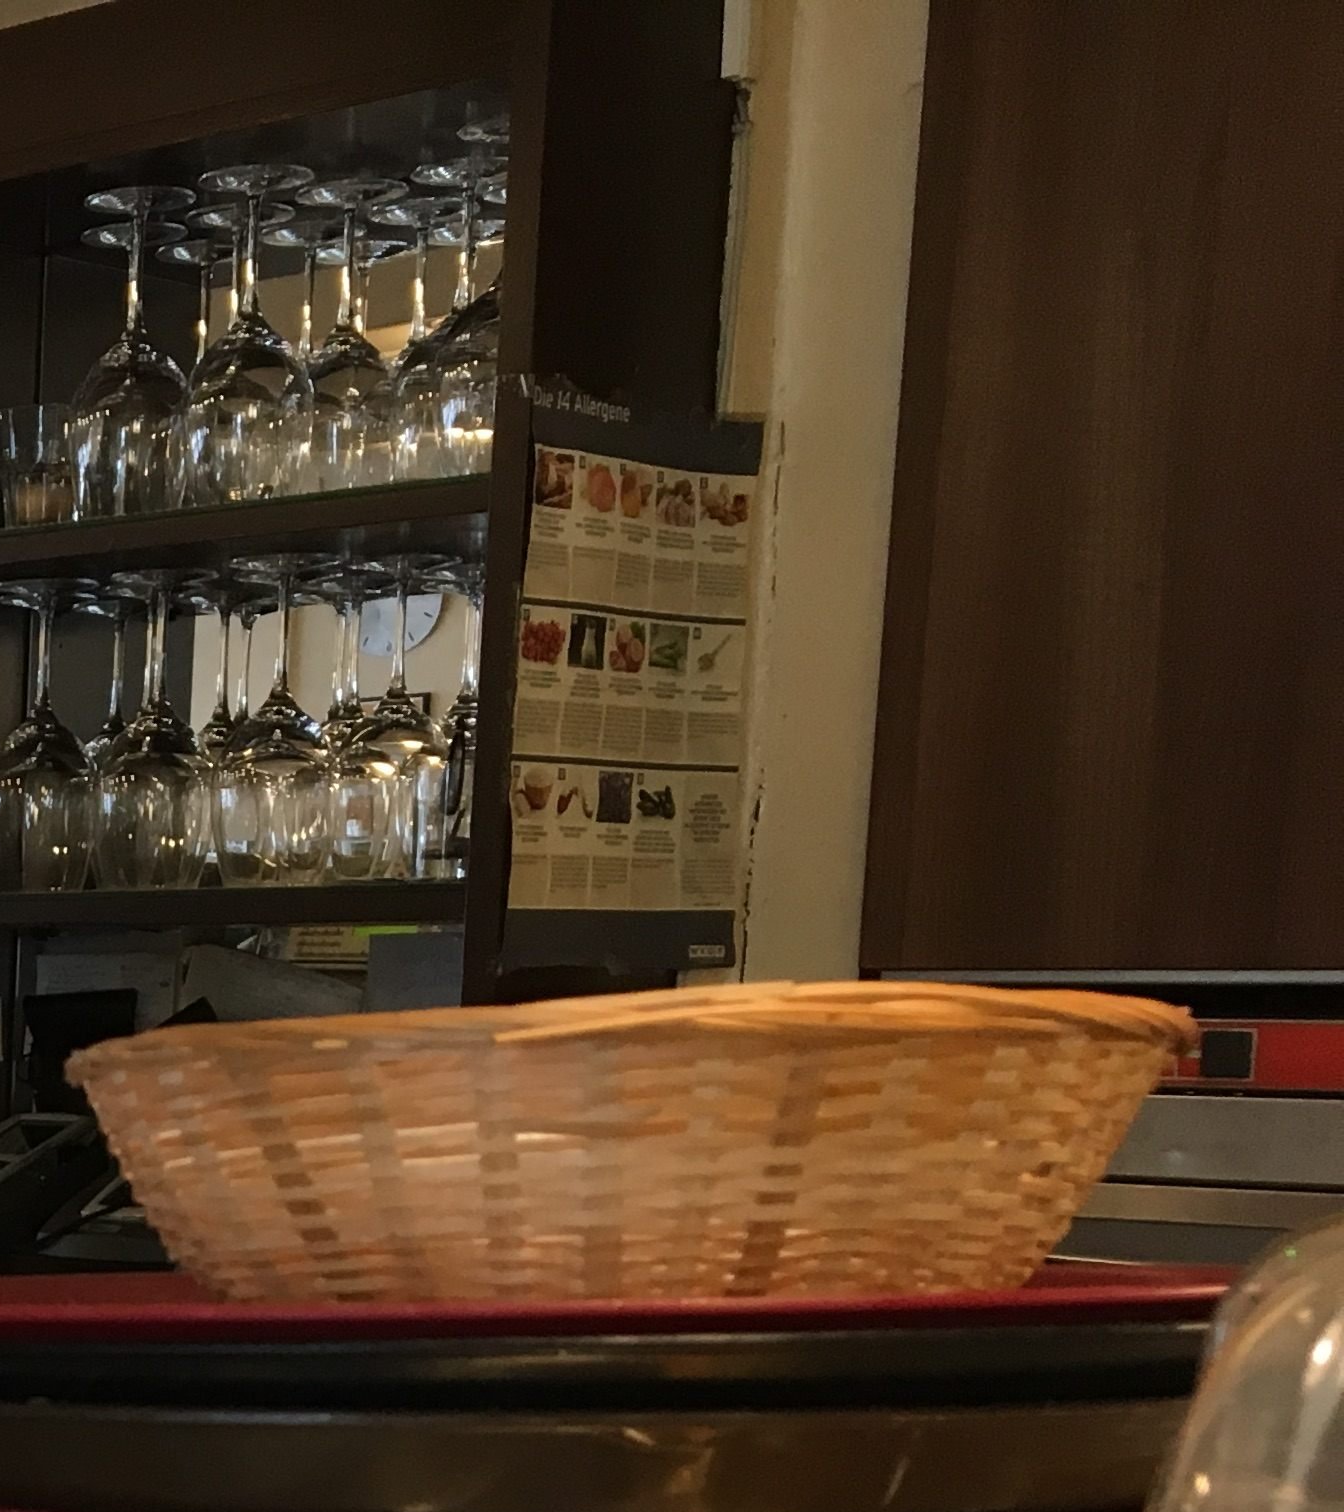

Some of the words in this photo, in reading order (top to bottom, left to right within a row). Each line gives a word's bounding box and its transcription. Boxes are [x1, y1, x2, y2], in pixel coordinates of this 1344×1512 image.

[533, 384, 554, 409] Die
[556, 390, 572, 411] 14
[574, 393, 632, 423] Allergene
